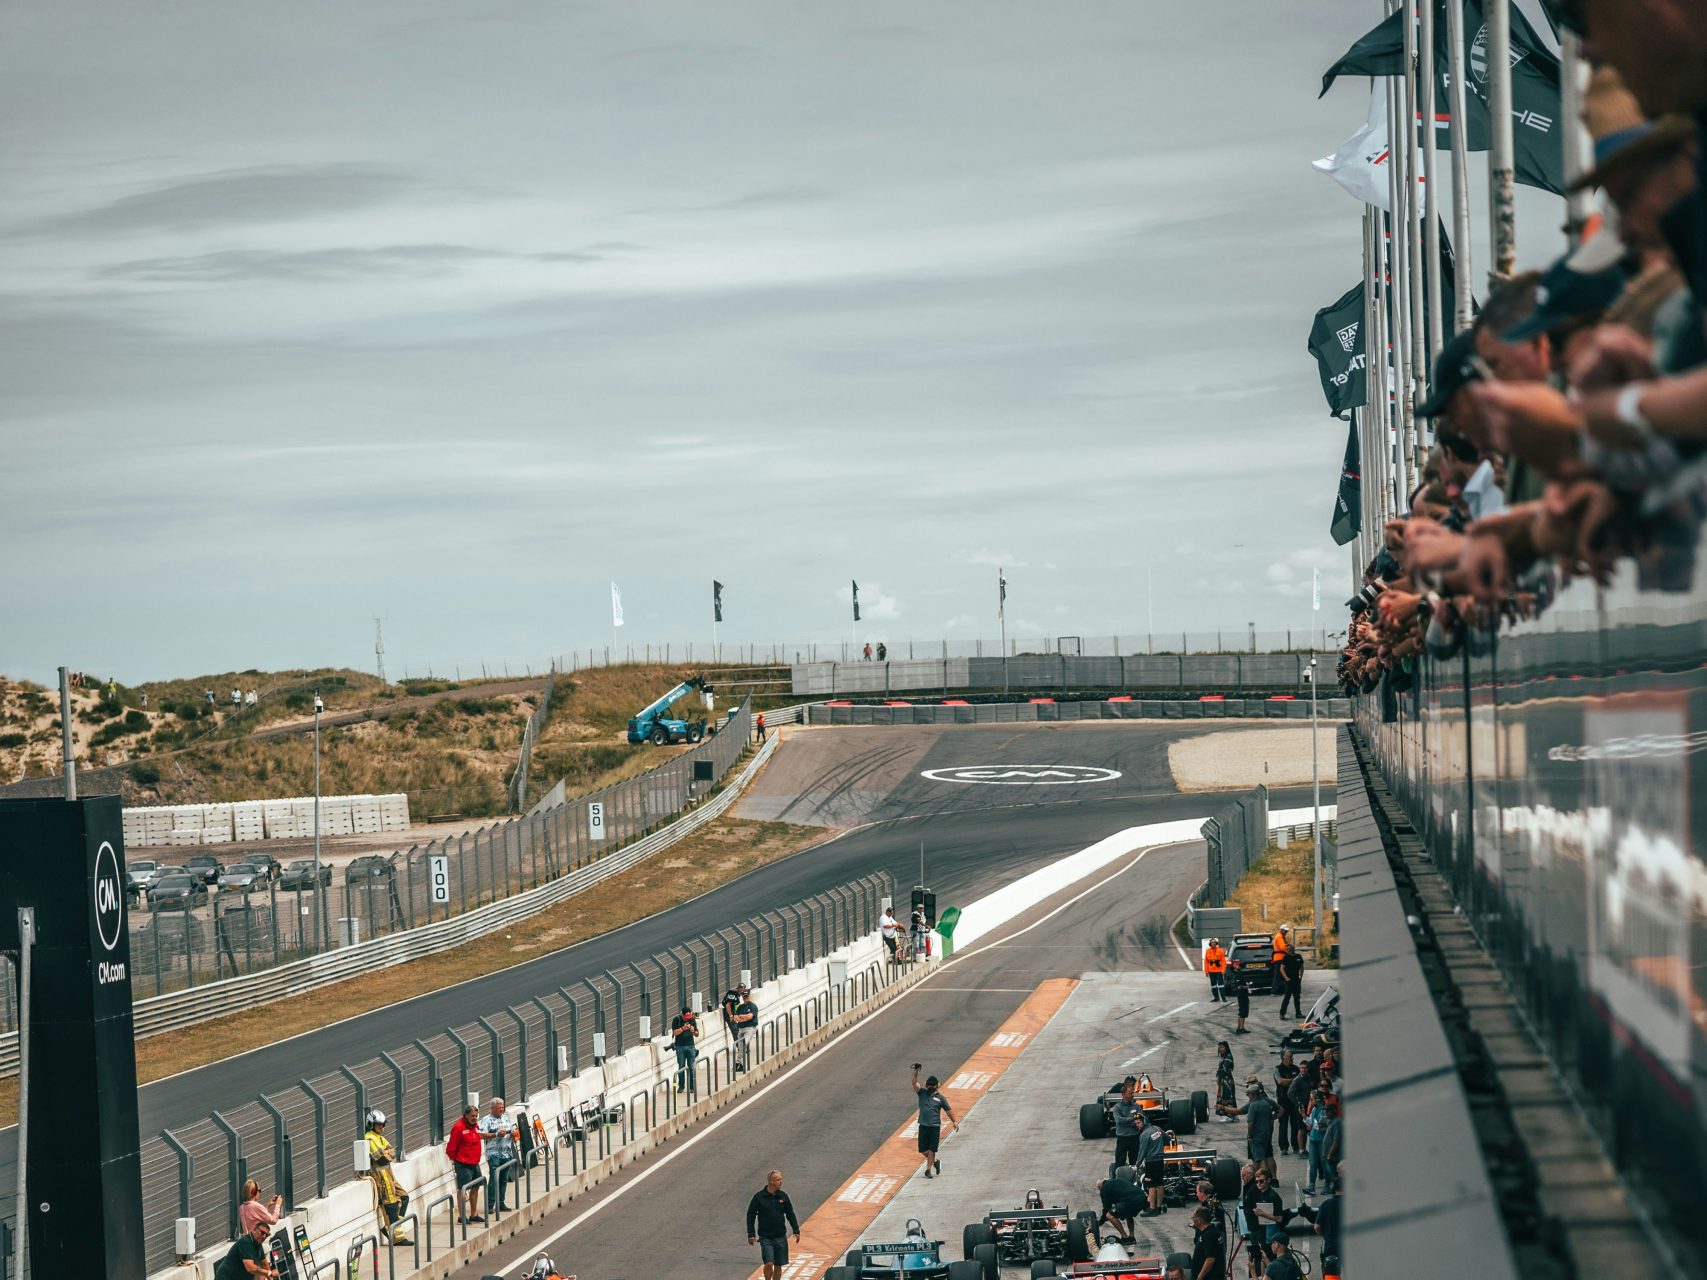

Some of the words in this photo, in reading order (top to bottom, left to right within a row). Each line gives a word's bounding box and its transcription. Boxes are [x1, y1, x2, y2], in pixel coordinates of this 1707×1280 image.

[592, 804, 601, 827] 50
[435, 859, 446, 900] 100
[98, 961, 125, 985] CM.com
[916, 1242, 932, 1251] PL3
